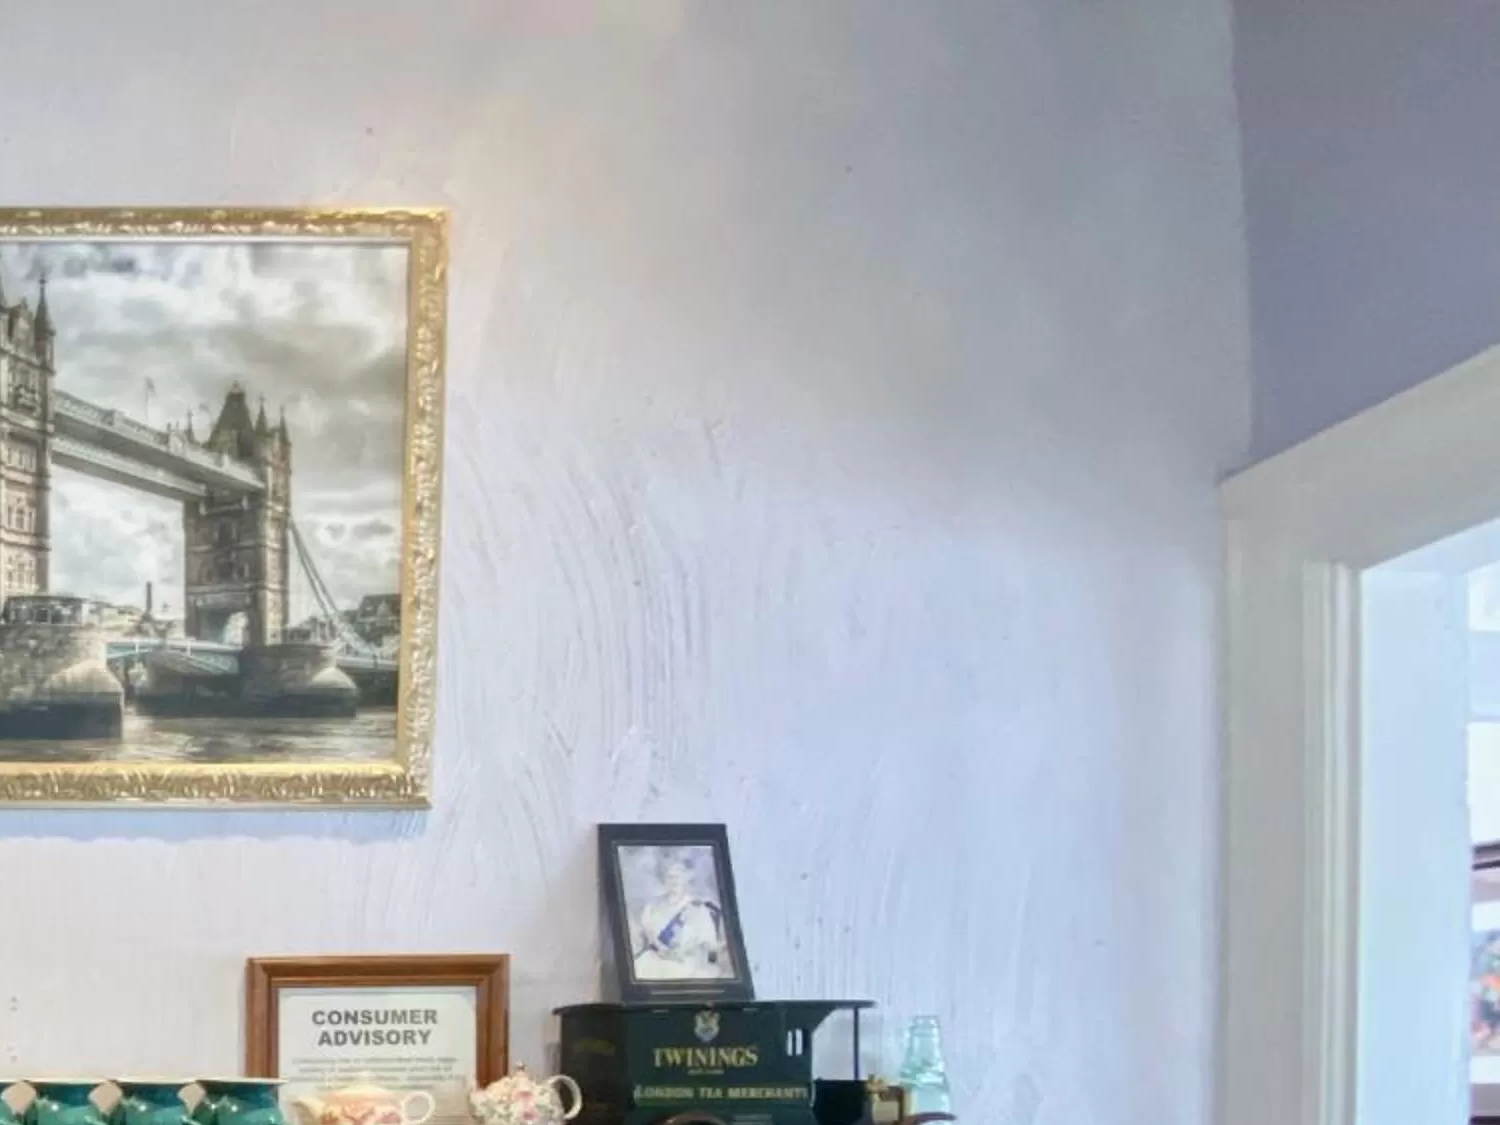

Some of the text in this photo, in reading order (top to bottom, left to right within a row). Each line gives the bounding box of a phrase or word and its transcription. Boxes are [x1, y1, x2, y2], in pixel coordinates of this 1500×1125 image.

[311, 1008, 438, 1025] CONSUMER
[318, 1029, 432, 1047] ADVISORY
[654, 1047, 758, 1068] TWININGS
[699, 1086, 723, 1098] TEA
